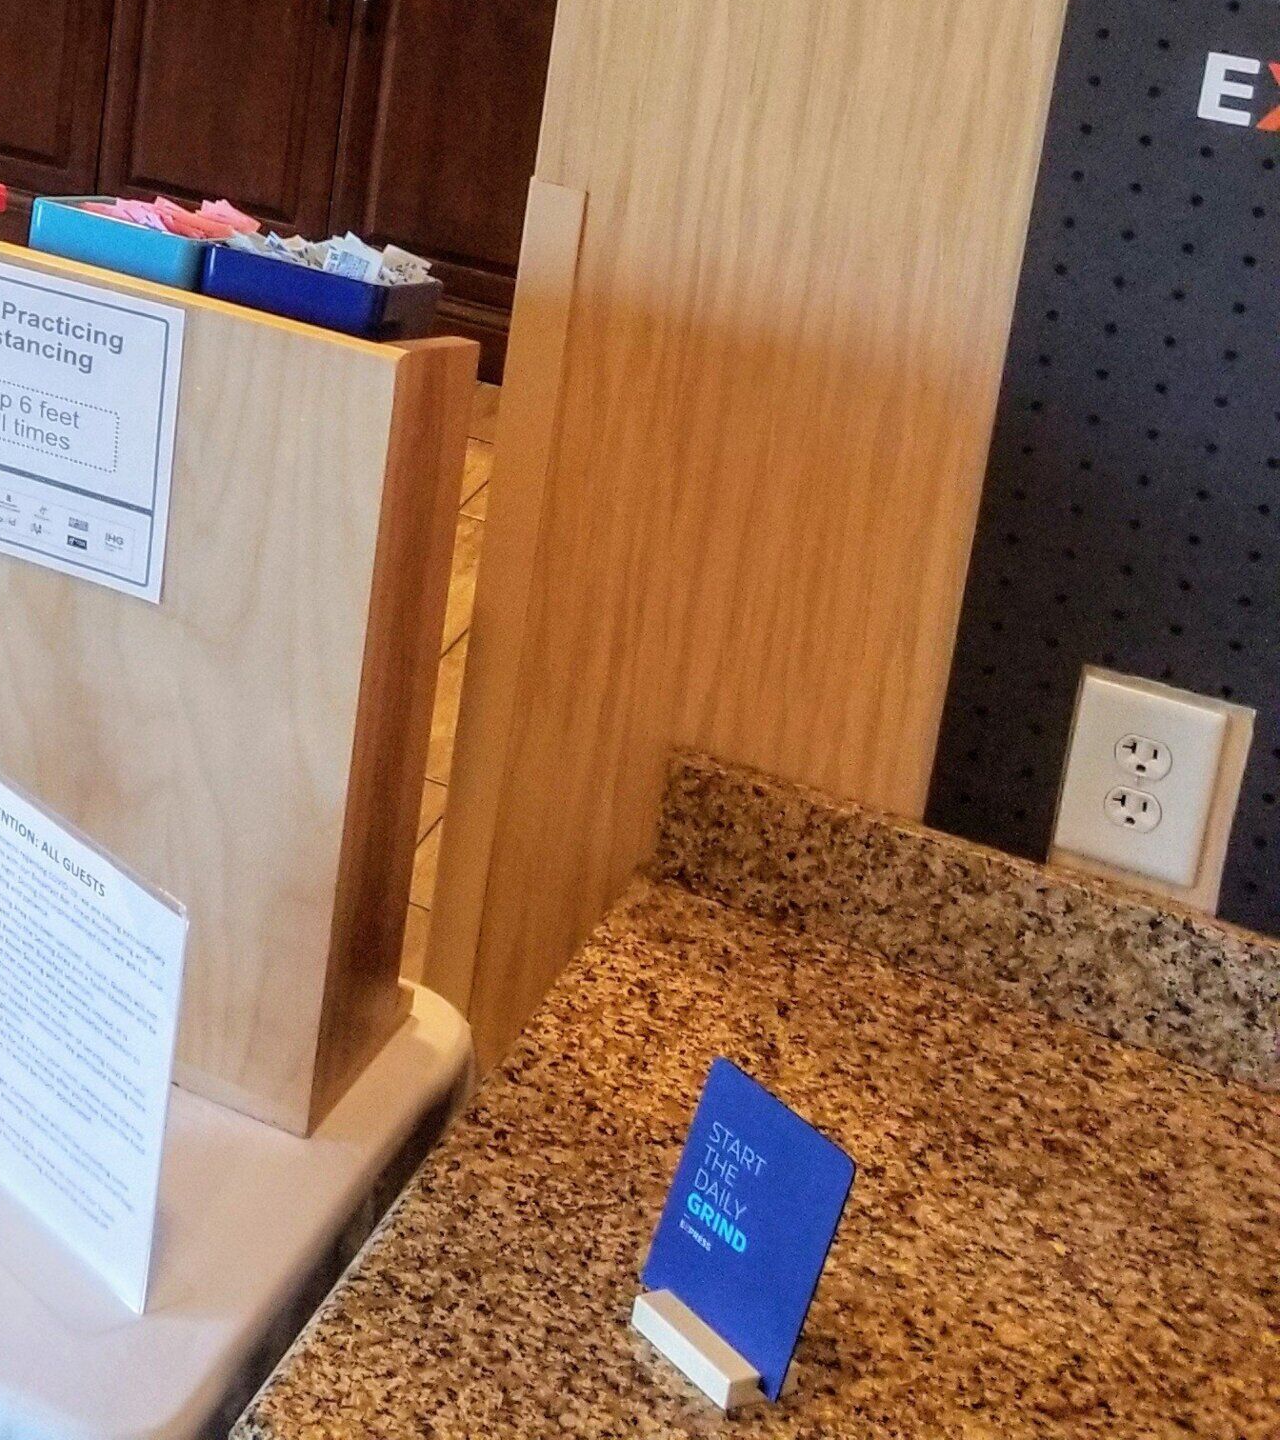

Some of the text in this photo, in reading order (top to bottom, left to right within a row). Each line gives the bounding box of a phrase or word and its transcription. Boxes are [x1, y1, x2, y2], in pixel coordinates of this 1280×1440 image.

[1197, 51, 1280, 131] E
[2, 301, 124, 354] Practicing
[14, 417, 70, 450] times
[19, 395, 33, 414] 6
[39, 399, 80, 430] feet
[105, 532, 124, 546] IHG
[41, 842, 60, 864] ALL
[63, 857, 106, 897] GUESTS
[705, 1143, 739, 1188] THE
[709, 1120, 767, 1177] START
[694, 1167, 747, 1221] DAILY
[687, 1192, 747, 1253] GRIND
